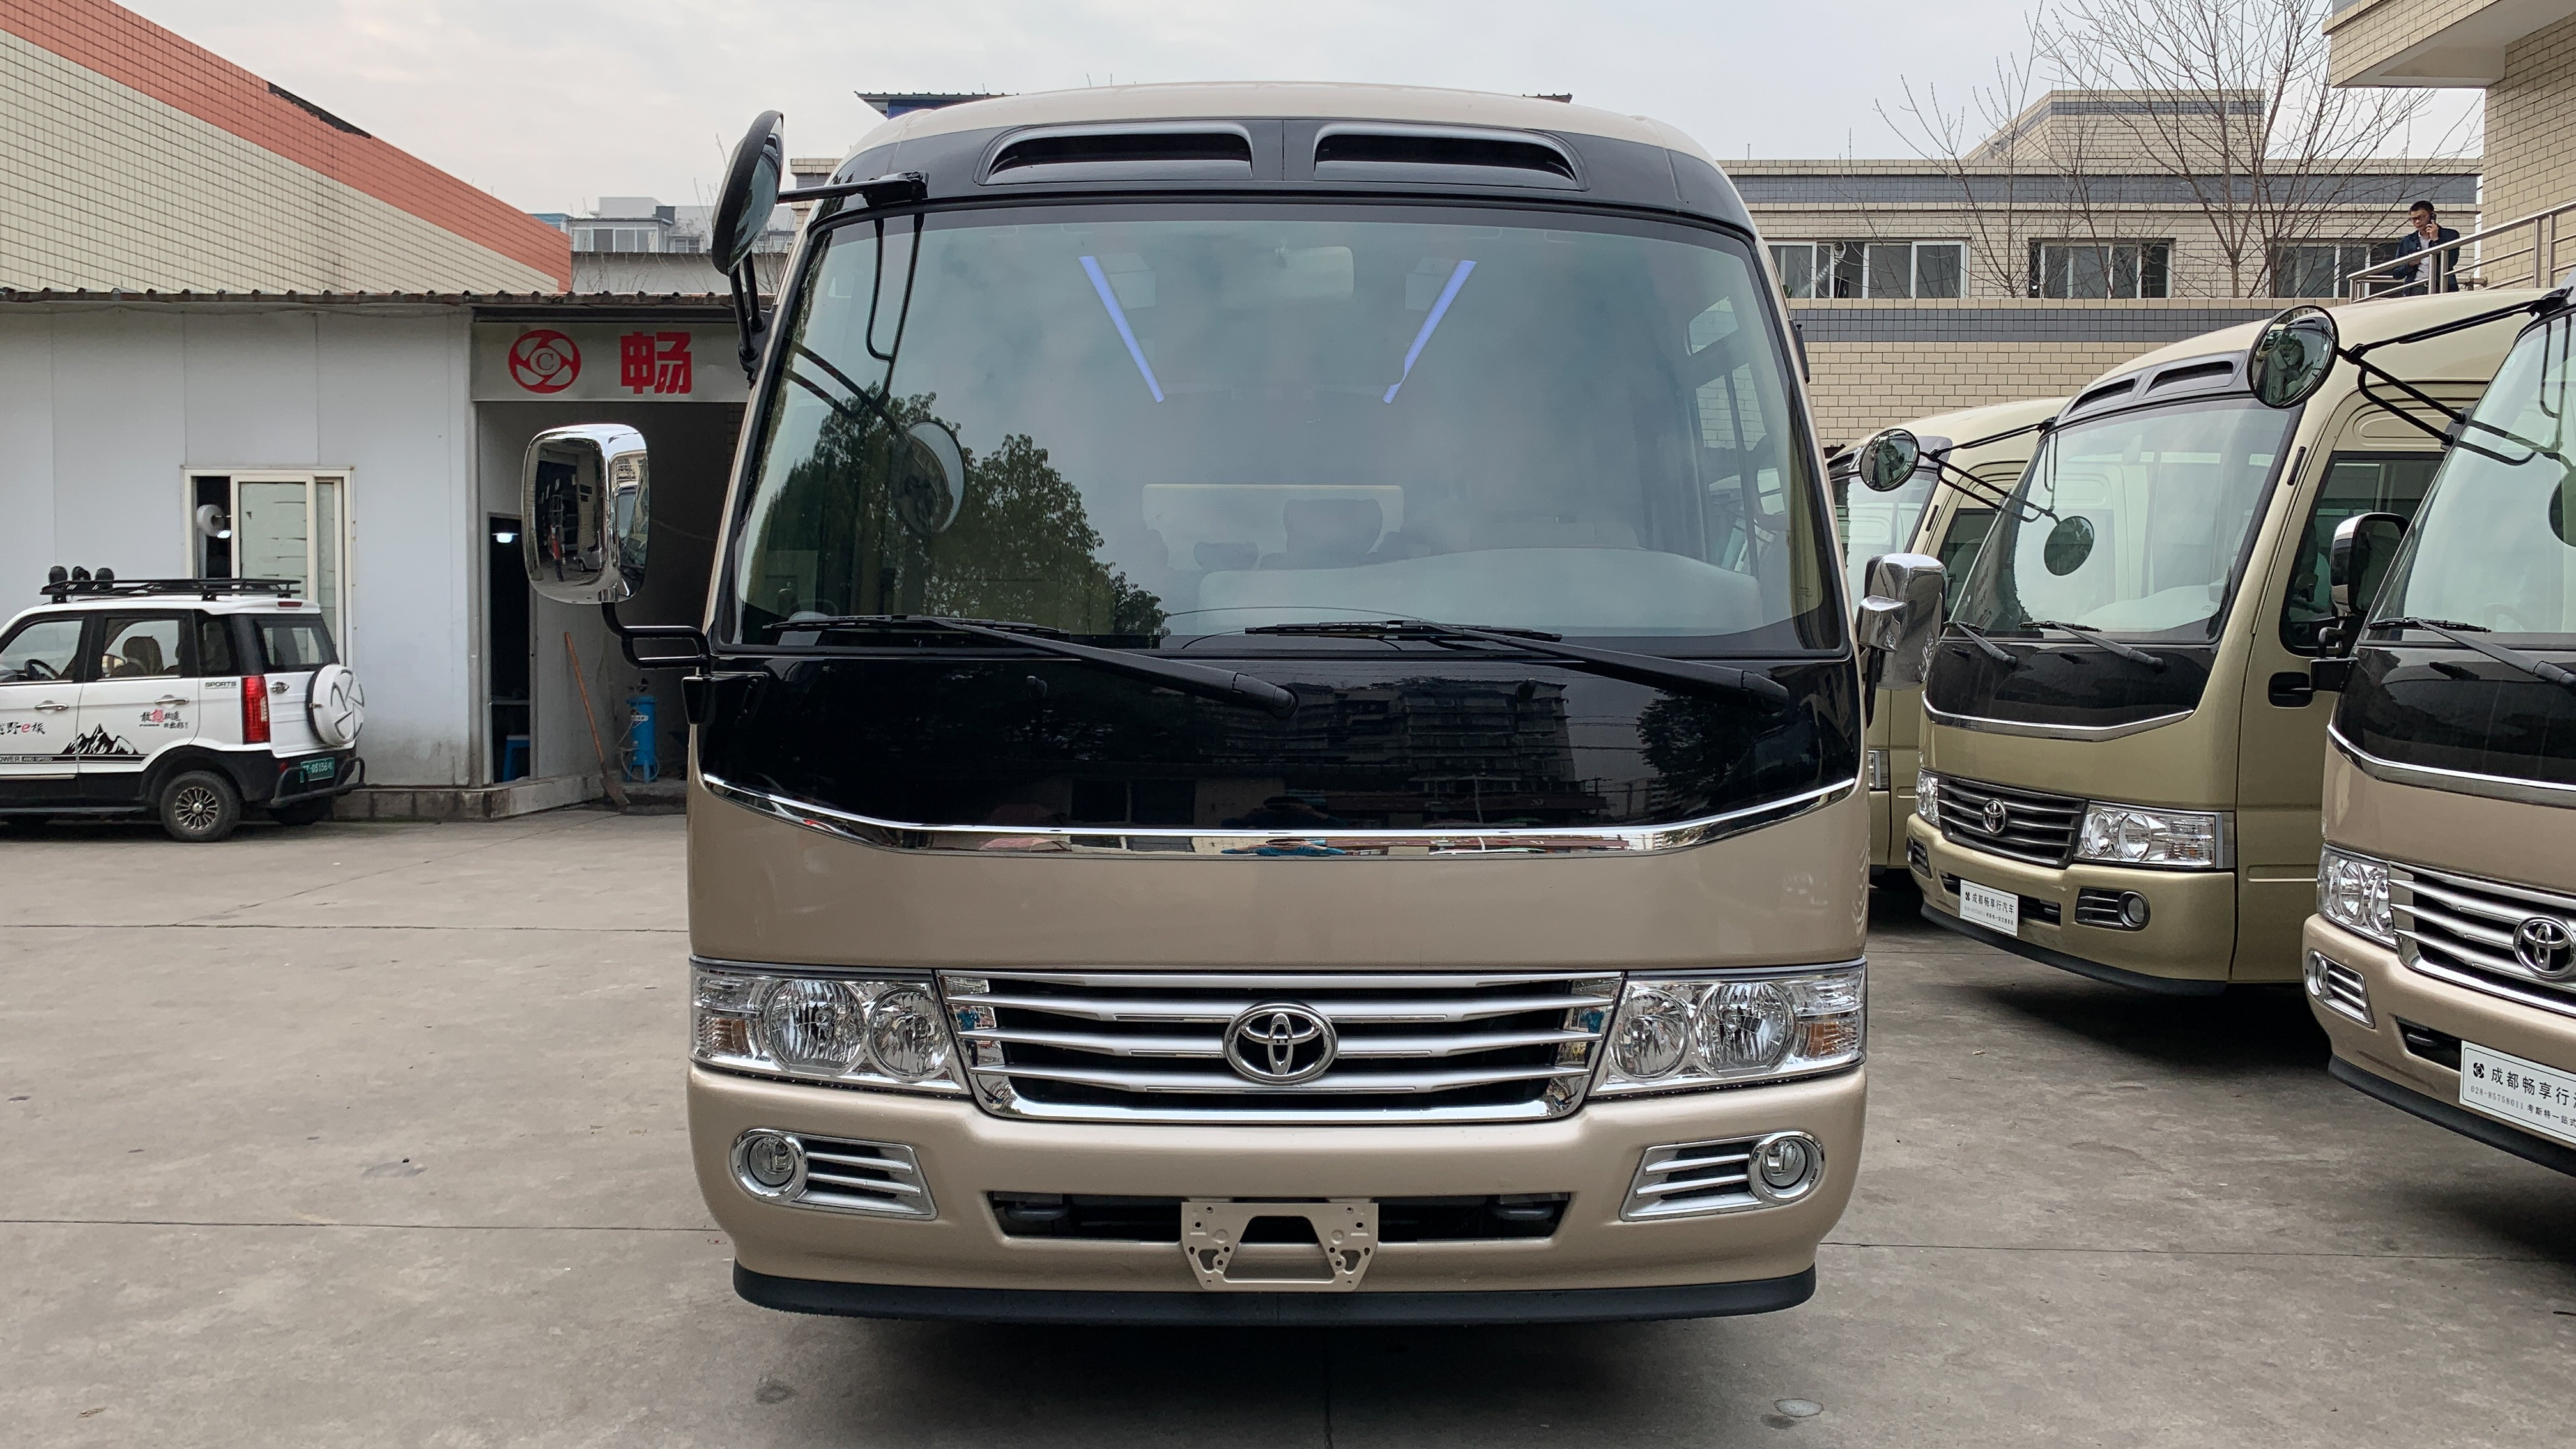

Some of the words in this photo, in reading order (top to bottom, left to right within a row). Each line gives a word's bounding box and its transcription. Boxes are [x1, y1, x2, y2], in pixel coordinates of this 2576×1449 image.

[620, 330, 692, 394] 畅
[2491, 1067, 2576, 1108] 成都畅享行
